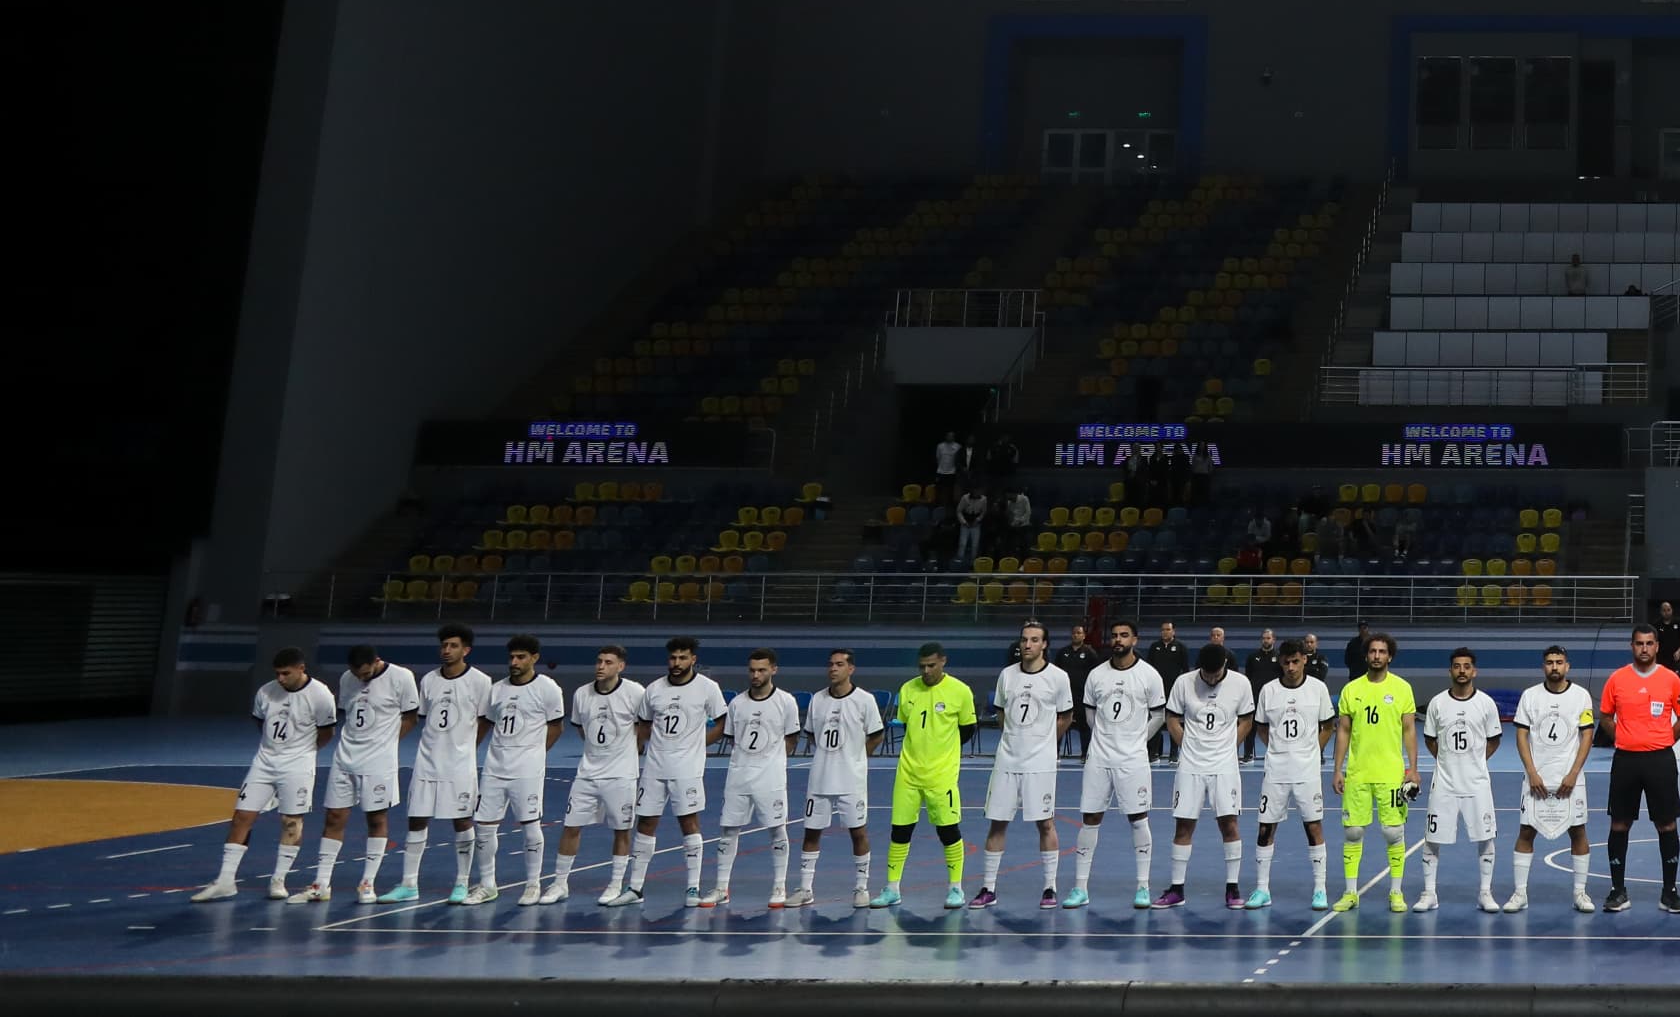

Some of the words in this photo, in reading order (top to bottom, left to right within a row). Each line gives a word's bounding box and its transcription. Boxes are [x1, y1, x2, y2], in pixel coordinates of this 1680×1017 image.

[530, 425, 612, 436] WELCOME
[614, 425, 636, 436] TO
[1079, 426, 1160, 438] WELCOME
[1164, 426, 1185, 438] TO
[1405, 426, 1487, 438] WELCOME
[1490, 426, 1513, 438] TO
[502, 442, 554, 464] HM
[562, 442, 670, 464] ARENA
[1054, 444, 1105, 465] HM
[1381, 444, 1431, 466] HM
[1440, 444, 1549, 466] ARENA
[356, 708, 365, 728] 5
[438, 709, 448, 729] 3
[921, 710, 928, 729] 1
[1020, 703, 1029, 723] 7
[1112, 701, 1121, 720] 9
[1365, 705, 1379, 725] 16
[272, 721, 287, 741] 14
[501, 716, 515, 735] 11
[664, 715, 678, 735] 12
[1205, 713, 1214, 731] 8
[1283, 719, 1298, 738] 13
[596, 726, 606, 745] 6
[750, 731, 759, 751] 2
[824, 729, 838, 748] 10
[1452, 731, 1467, 751] 15
[1547, 723, 1558, 742] 4
